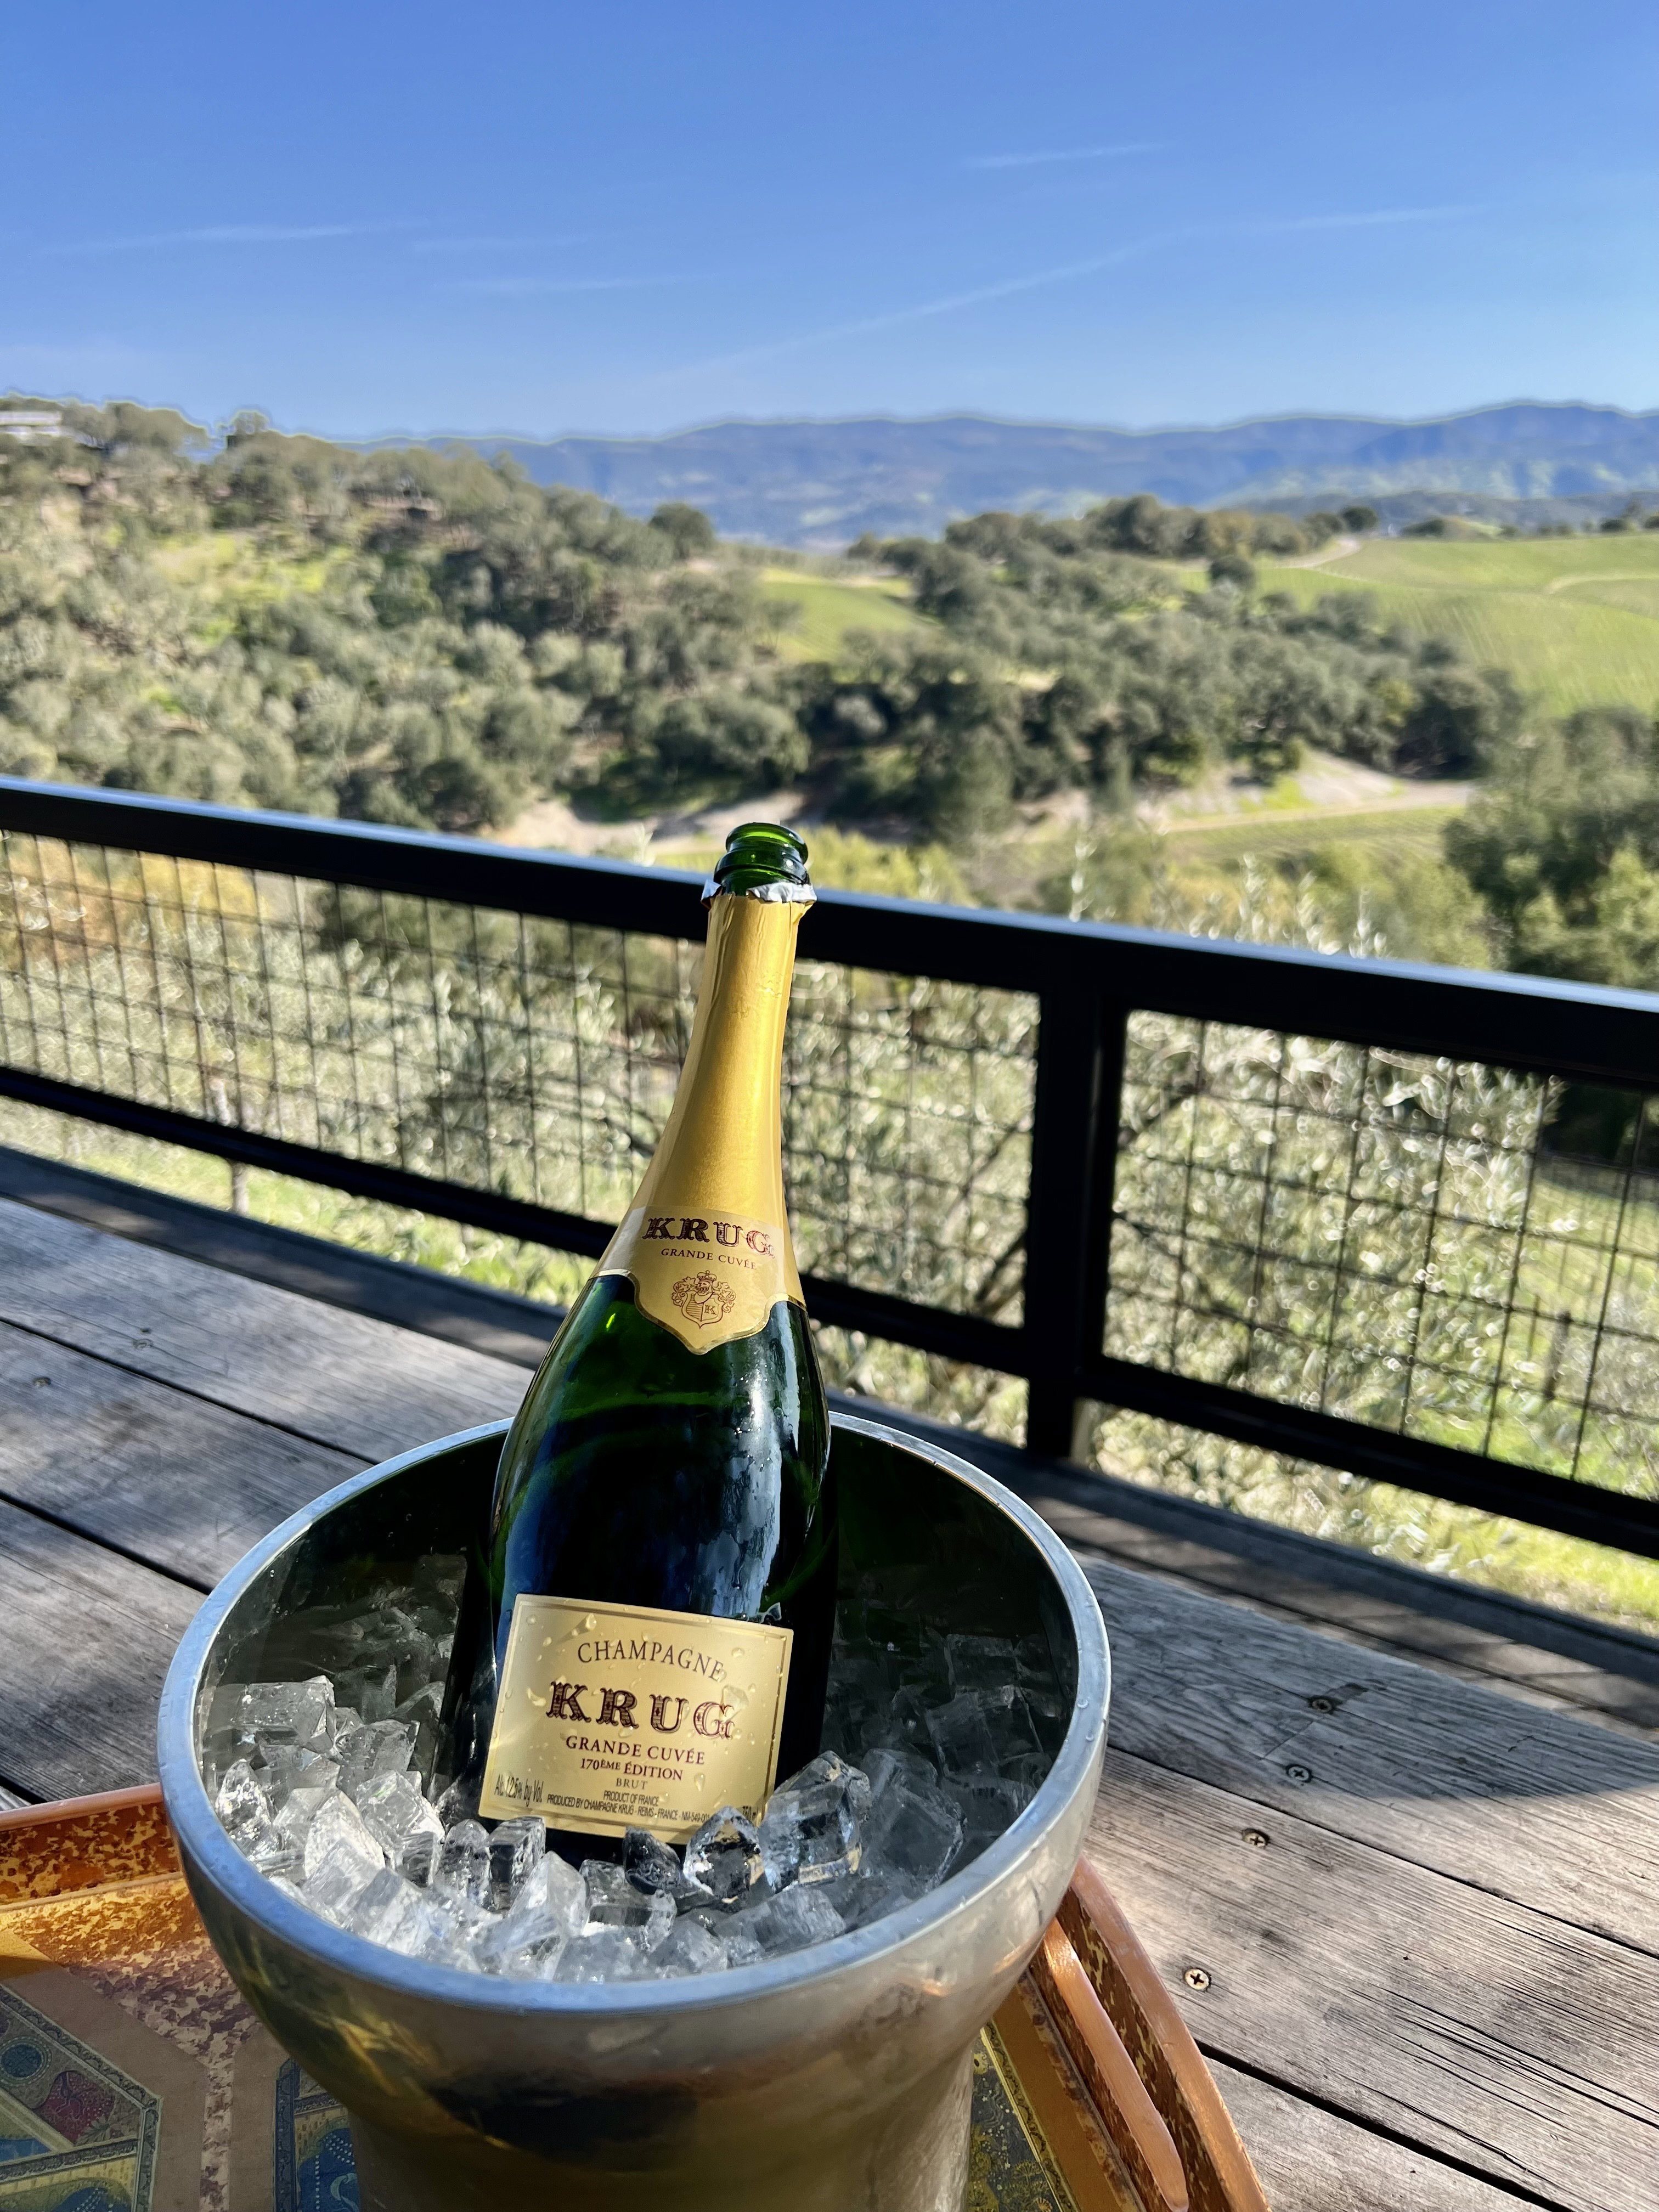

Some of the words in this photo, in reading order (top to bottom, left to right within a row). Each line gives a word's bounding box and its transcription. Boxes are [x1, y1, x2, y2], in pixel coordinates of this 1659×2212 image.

[642, 1217, 775, 1259] KRUG
[661, 1248, 713, 1261] GRANDE
[718, 1254, 757, 1270] CUVÉE
[578, 1639, 724, 1683] CHAMPAGNE
[546, 1681, 735, 1740] KRUG
[566, 1735, 641, 1757] GRANDE
[647, 1746, 705, 1765] CUVÉE
[616, 1777, 648, 1790] BRUT
[623, 1760, 684, 1781] ÉDITION
[523, 1778, 532, 1807] by
[546, 1793, 575, 1808] PRODUCED
[575, 1797, 584, 1809] BY
[584, 1799, 618, 1813] CHAMPAGNE
[618, 1803, 634, 1815] KRUG
[637, 1805, 654, 1818] REIMS
[658, 1808, 679, 1820] FRANCE
[603, 1790, 630, 1803] PRODUCT
[630, 1793, 638, 1804] OF
[638, 1794, 659, 1807] FRANCE
